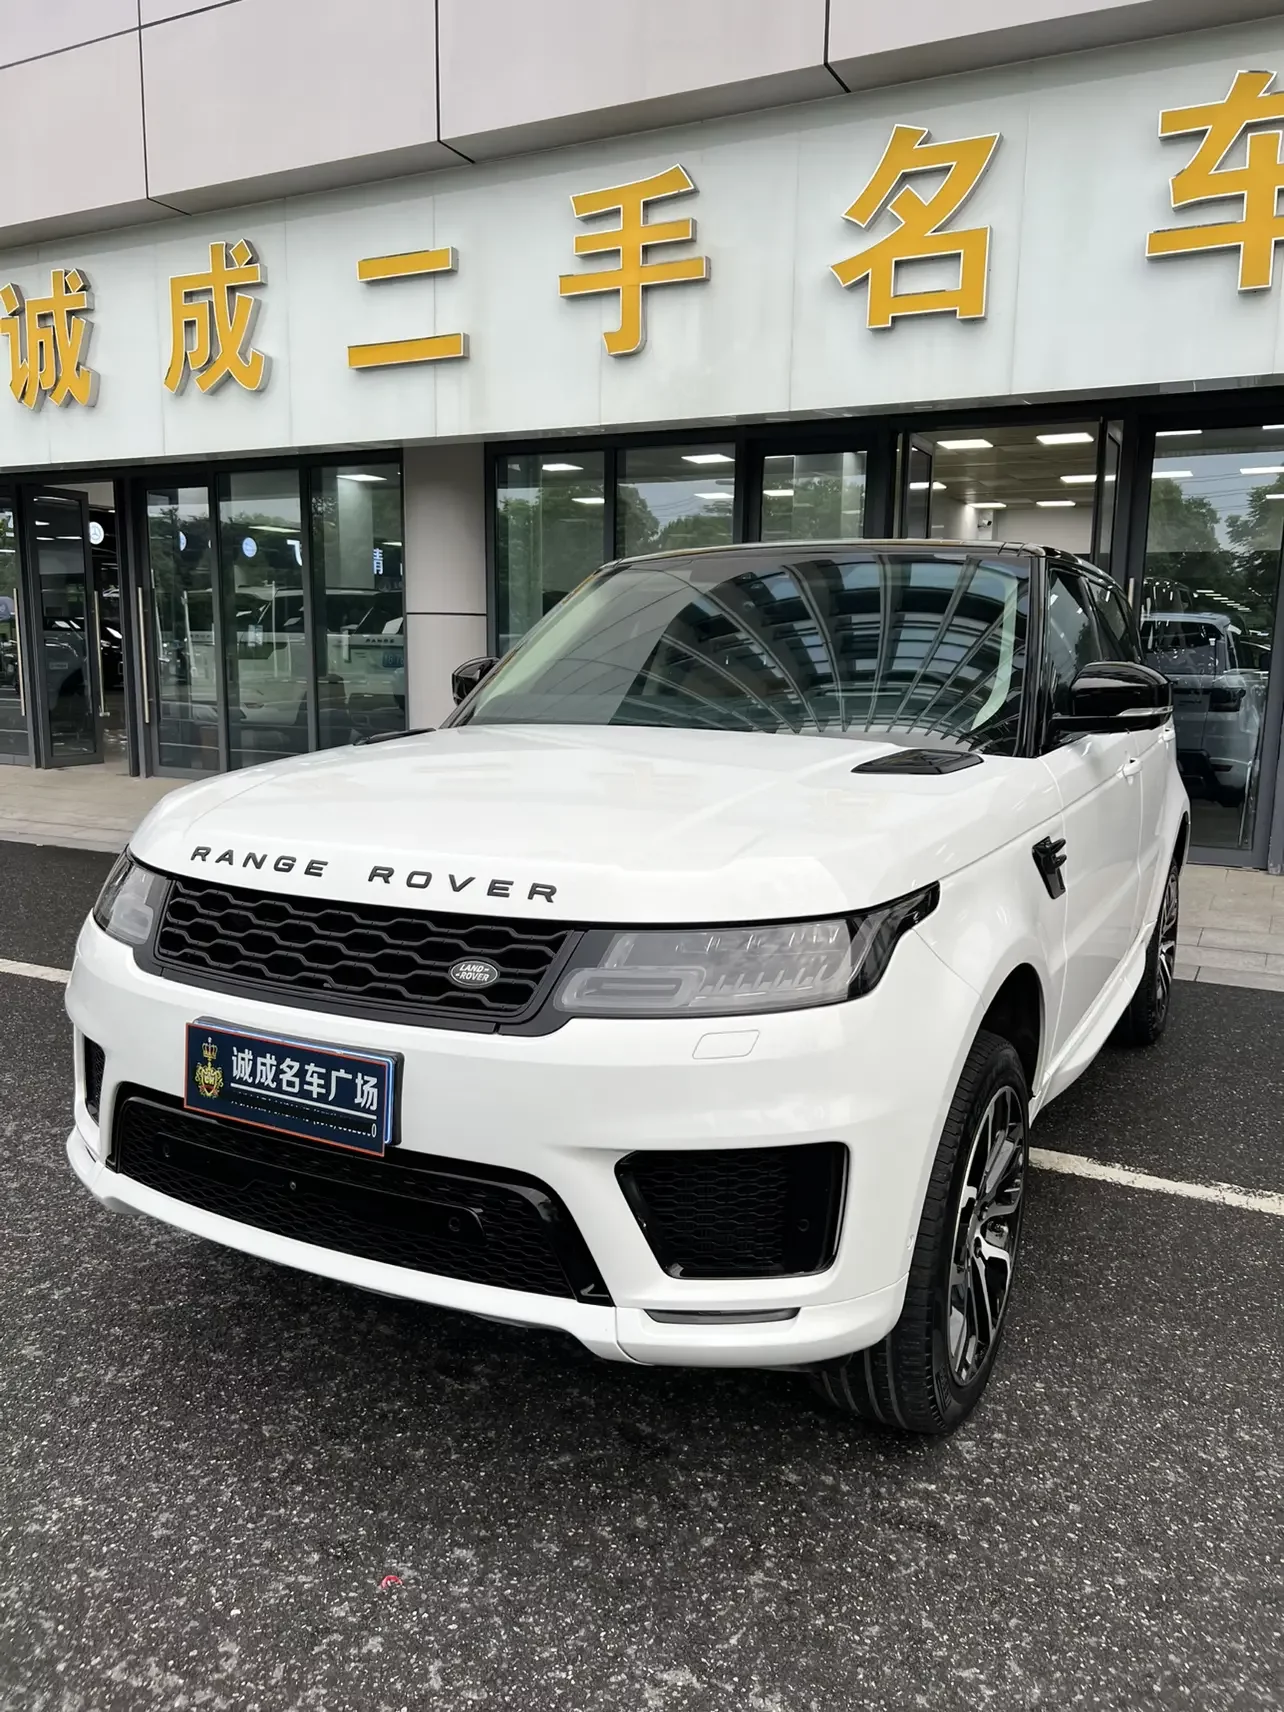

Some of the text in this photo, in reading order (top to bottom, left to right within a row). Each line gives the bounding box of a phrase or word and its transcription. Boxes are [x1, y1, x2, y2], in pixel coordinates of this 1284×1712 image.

[0, 69, 1284, 411] 诚成二手名车
[191, 846, 558, 903] RANGE ROVER
[459, 971, 490, 982] ROVER
[231, 1046, 379, 1111] 诚成名车广场
